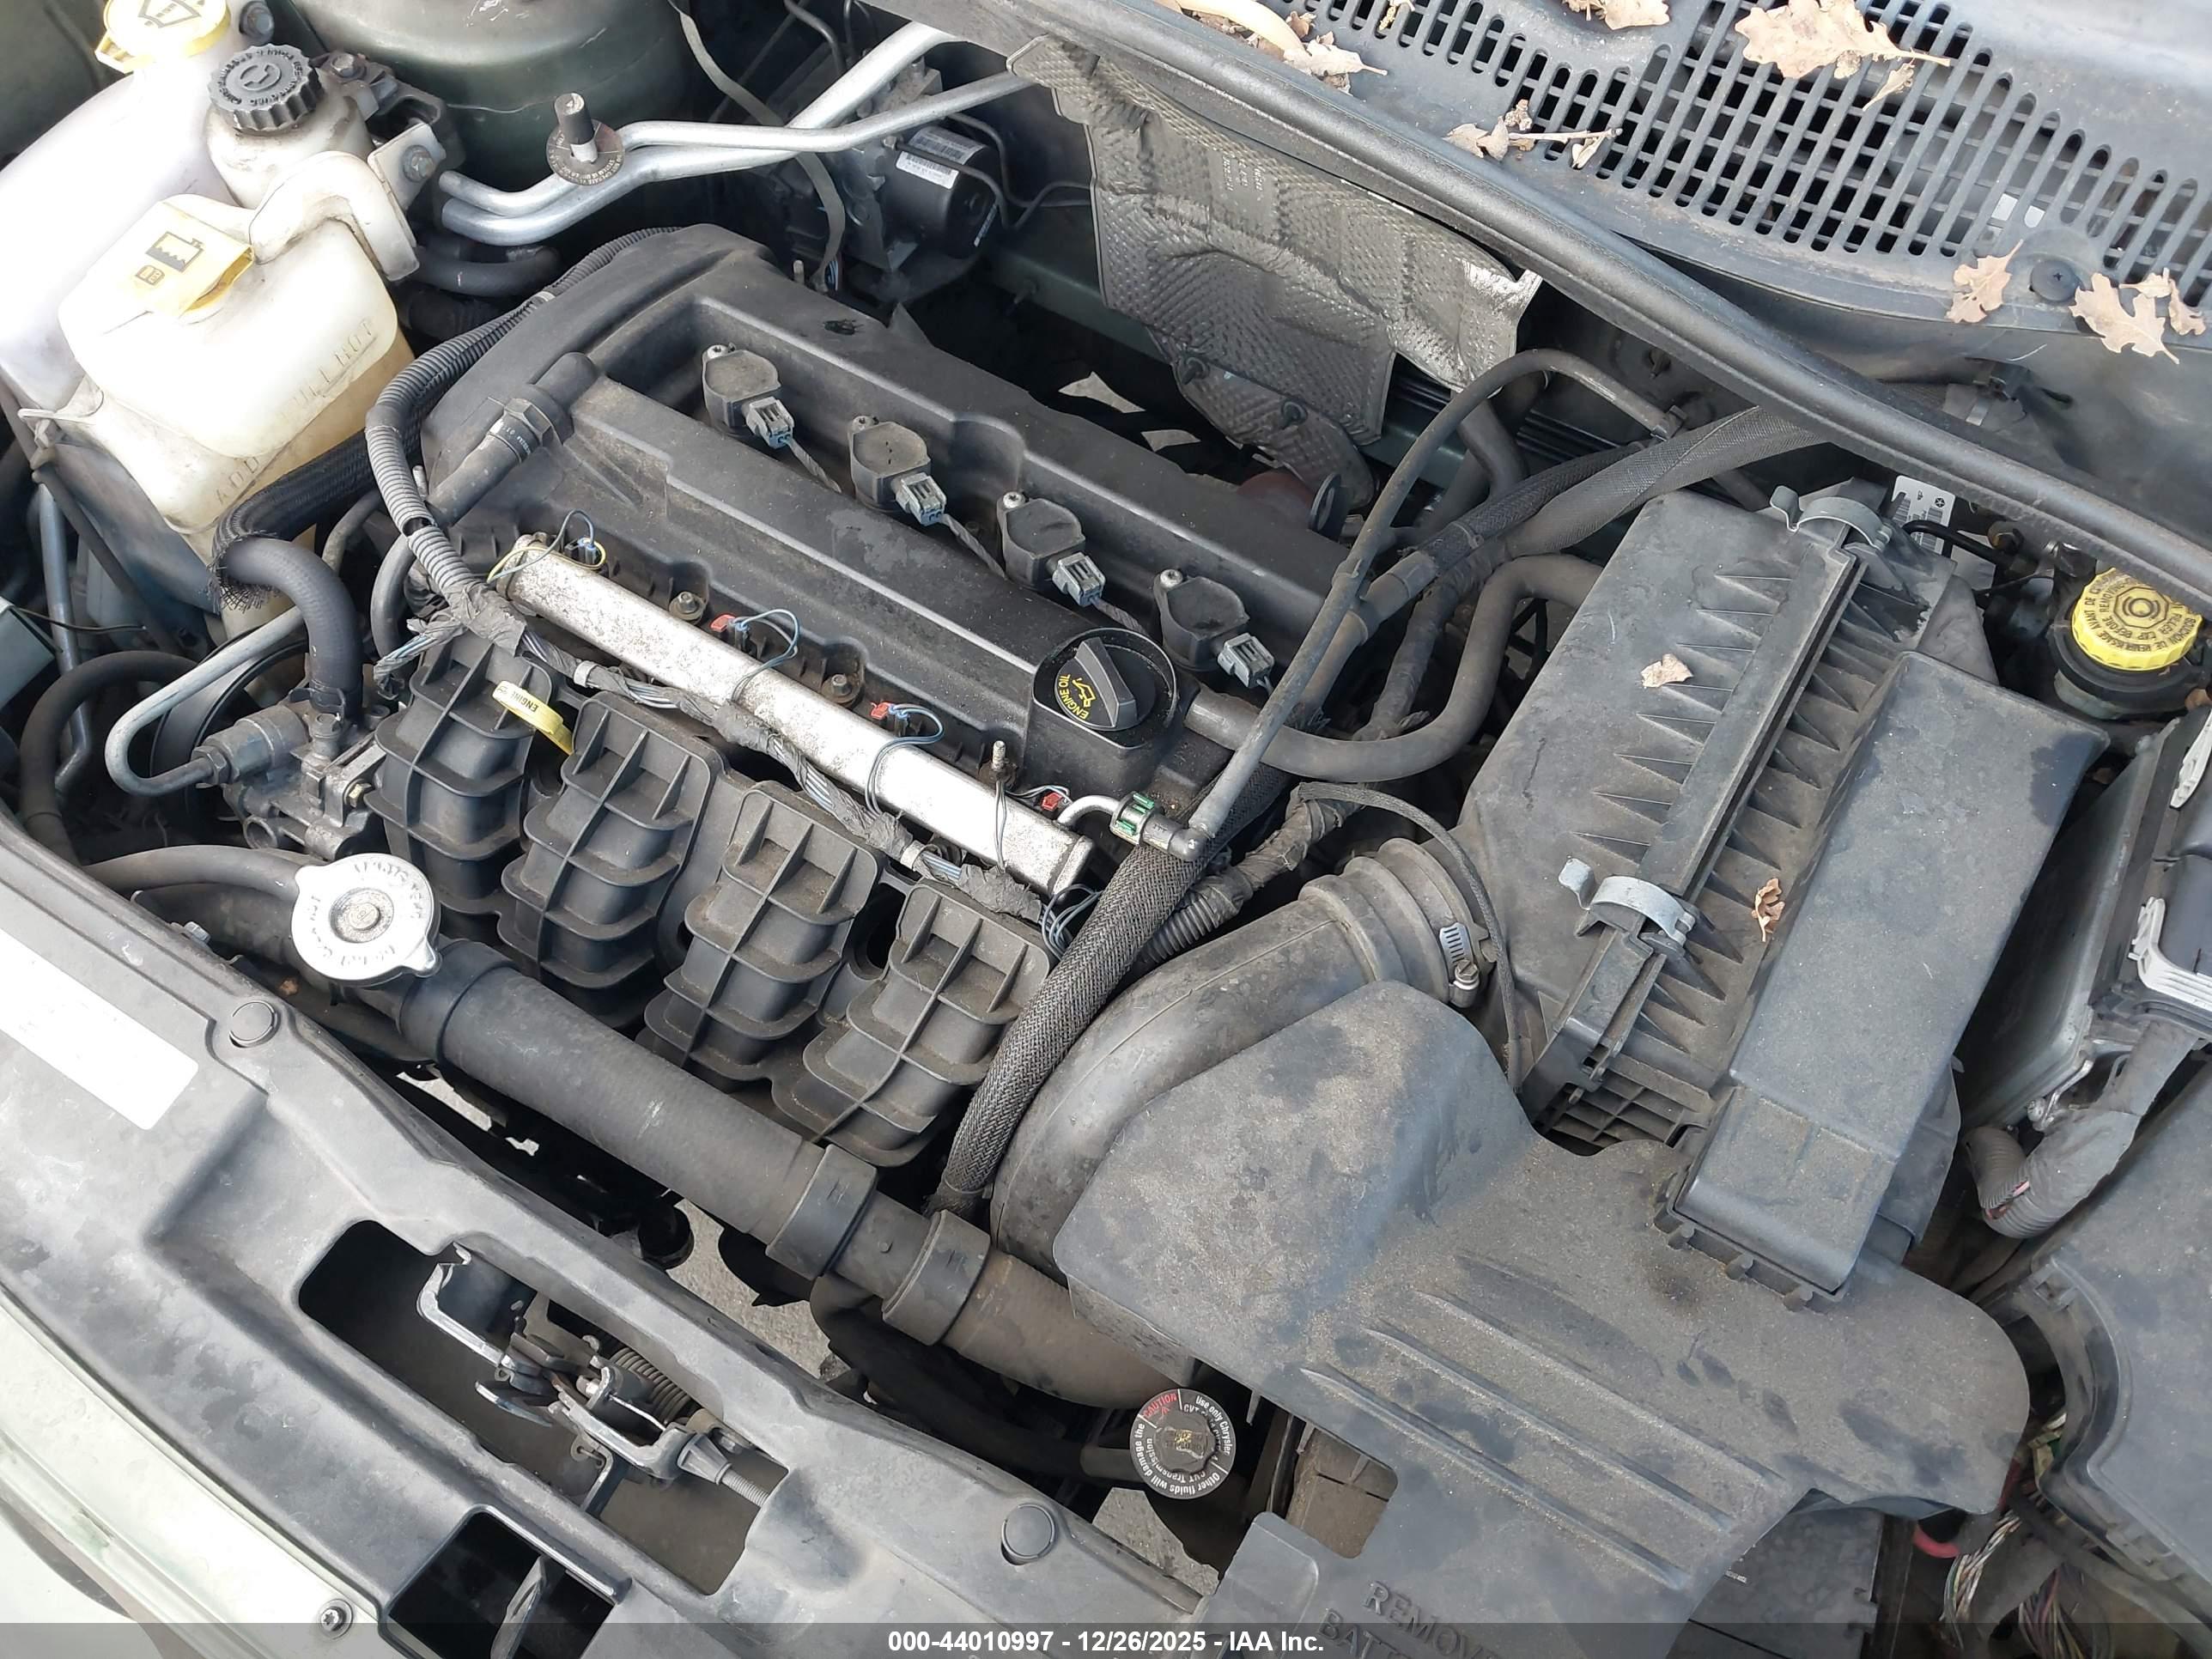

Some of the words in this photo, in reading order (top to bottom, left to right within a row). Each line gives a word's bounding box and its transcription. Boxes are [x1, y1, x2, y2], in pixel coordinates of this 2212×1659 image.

[2084, 597, 2096, 606] DE
[2083, 610, 2101, 631] AVANT
[2101, 615, 2133, 639] BEFORE
[2157, 612, 2182, 635] FILLER
[2170, 617, 2197, 645] BOUCHON
[2098, 631, 2152, 653] REMPLISSAGE
[2136, 630, 2157, 641] CAP
[2156, 640, 2168, 650] DE
[1058, 674, 1071, 688] OIL
[1059, 688, 1090, 720] ENGINE
[1143, 1392, 1177, 1419] CAUTION
[1133, 1422, 1146, 1438] the
[1195, 1395, 1210, 1408] Use
[1208, 1405, 1224, 1422] only
[1219, 1420, 1233, 1455] Chrysler
[1134, 1440, 1154, 1477] damage
[1146, 1437, 1186, 1484] Transmission
[1151, 1474, 1169, 1490] will
[1169, 1484, 1196, 1496] fluids
[1197, 1472, 1220, 1492] Other
